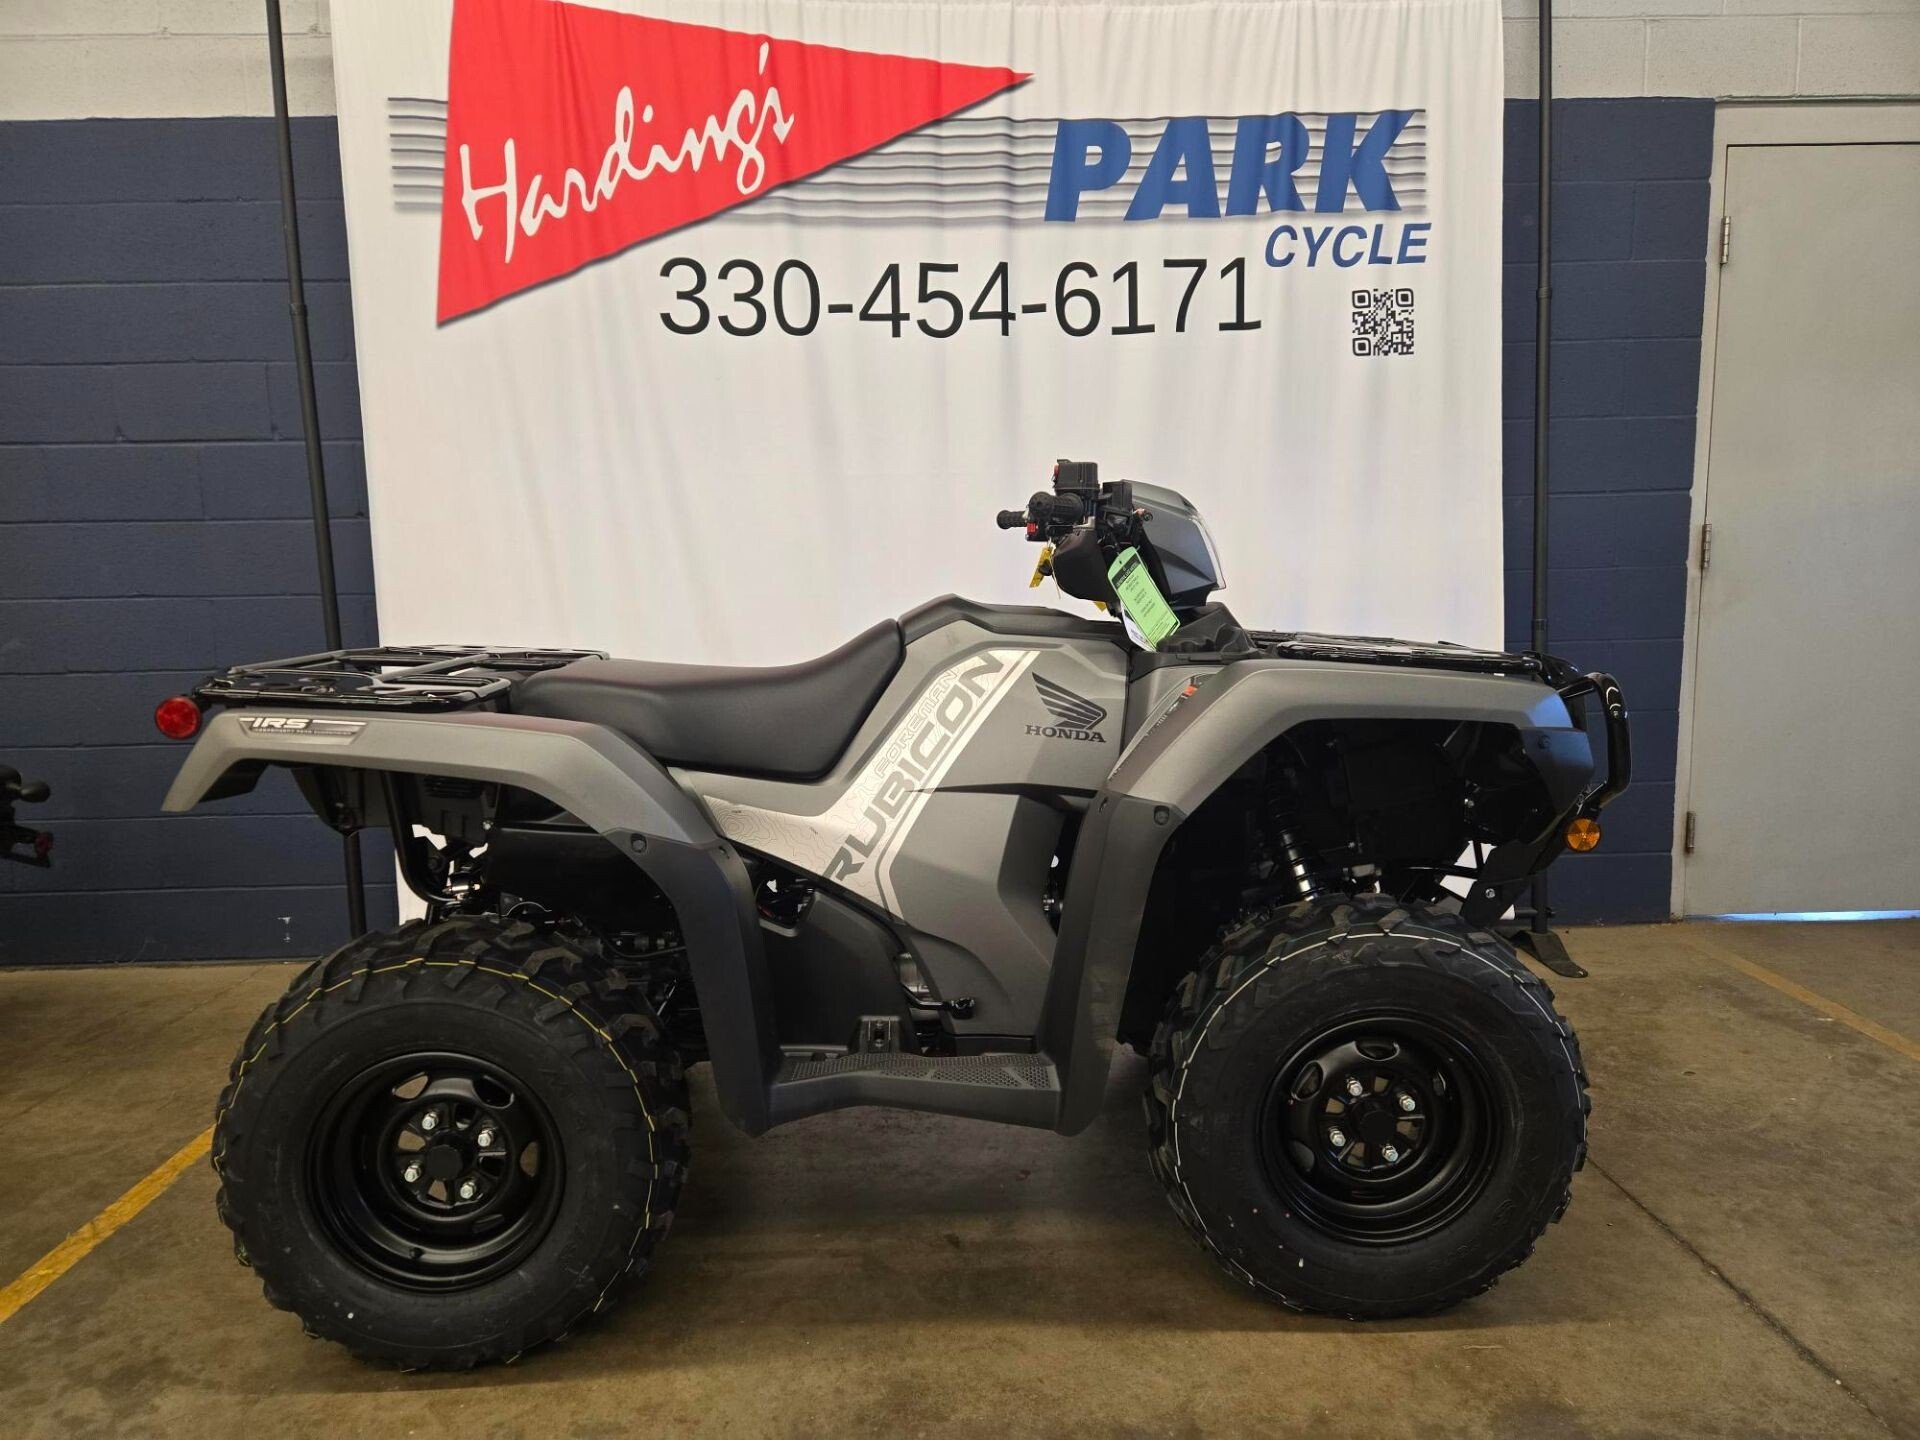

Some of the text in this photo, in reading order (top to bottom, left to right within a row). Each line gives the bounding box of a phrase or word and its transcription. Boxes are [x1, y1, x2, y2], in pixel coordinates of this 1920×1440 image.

[460, 42, 795, 263] Harding's
[1044, 111, 1414, 221] PARK
[1264, 222, 1432, 267] CYCLE
[659, 257, 1261, 338] 330-454-6171
[253, 717, 310, 729] IRS
[821, 651, 1005, 881] RUBICON
[873, 669, 957, 779] FOREMAN
[1025, 724, 1106, 743] HONDA
